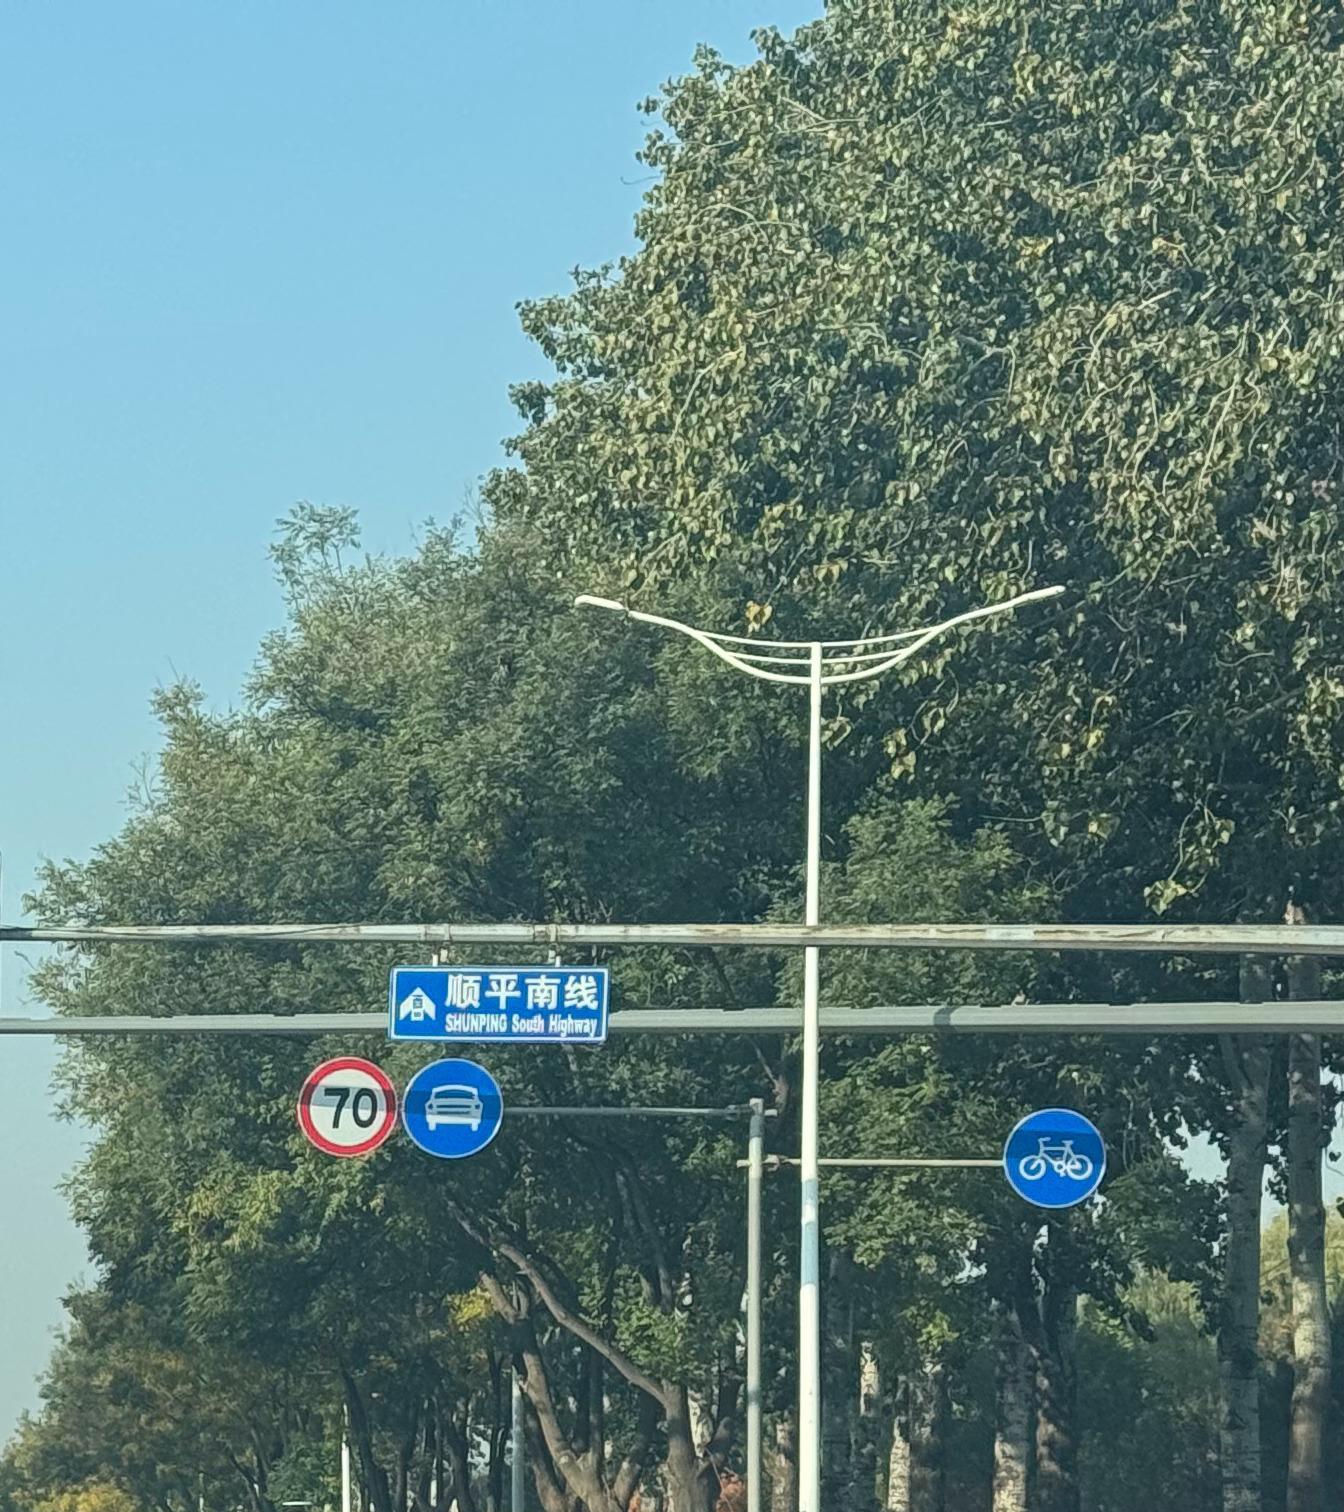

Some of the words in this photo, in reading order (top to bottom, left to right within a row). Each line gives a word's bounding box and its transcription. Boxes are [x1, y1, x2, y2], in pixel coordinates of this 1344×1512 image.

[445, 974, 599, 1010] 顺平南线
[445, 1013, 507, 1033] SHUNPING
[512, 1014, 544, 1033] South
[548, 1014, 597, 1037] Highway
[324, 1087, 378, 1129] 70
